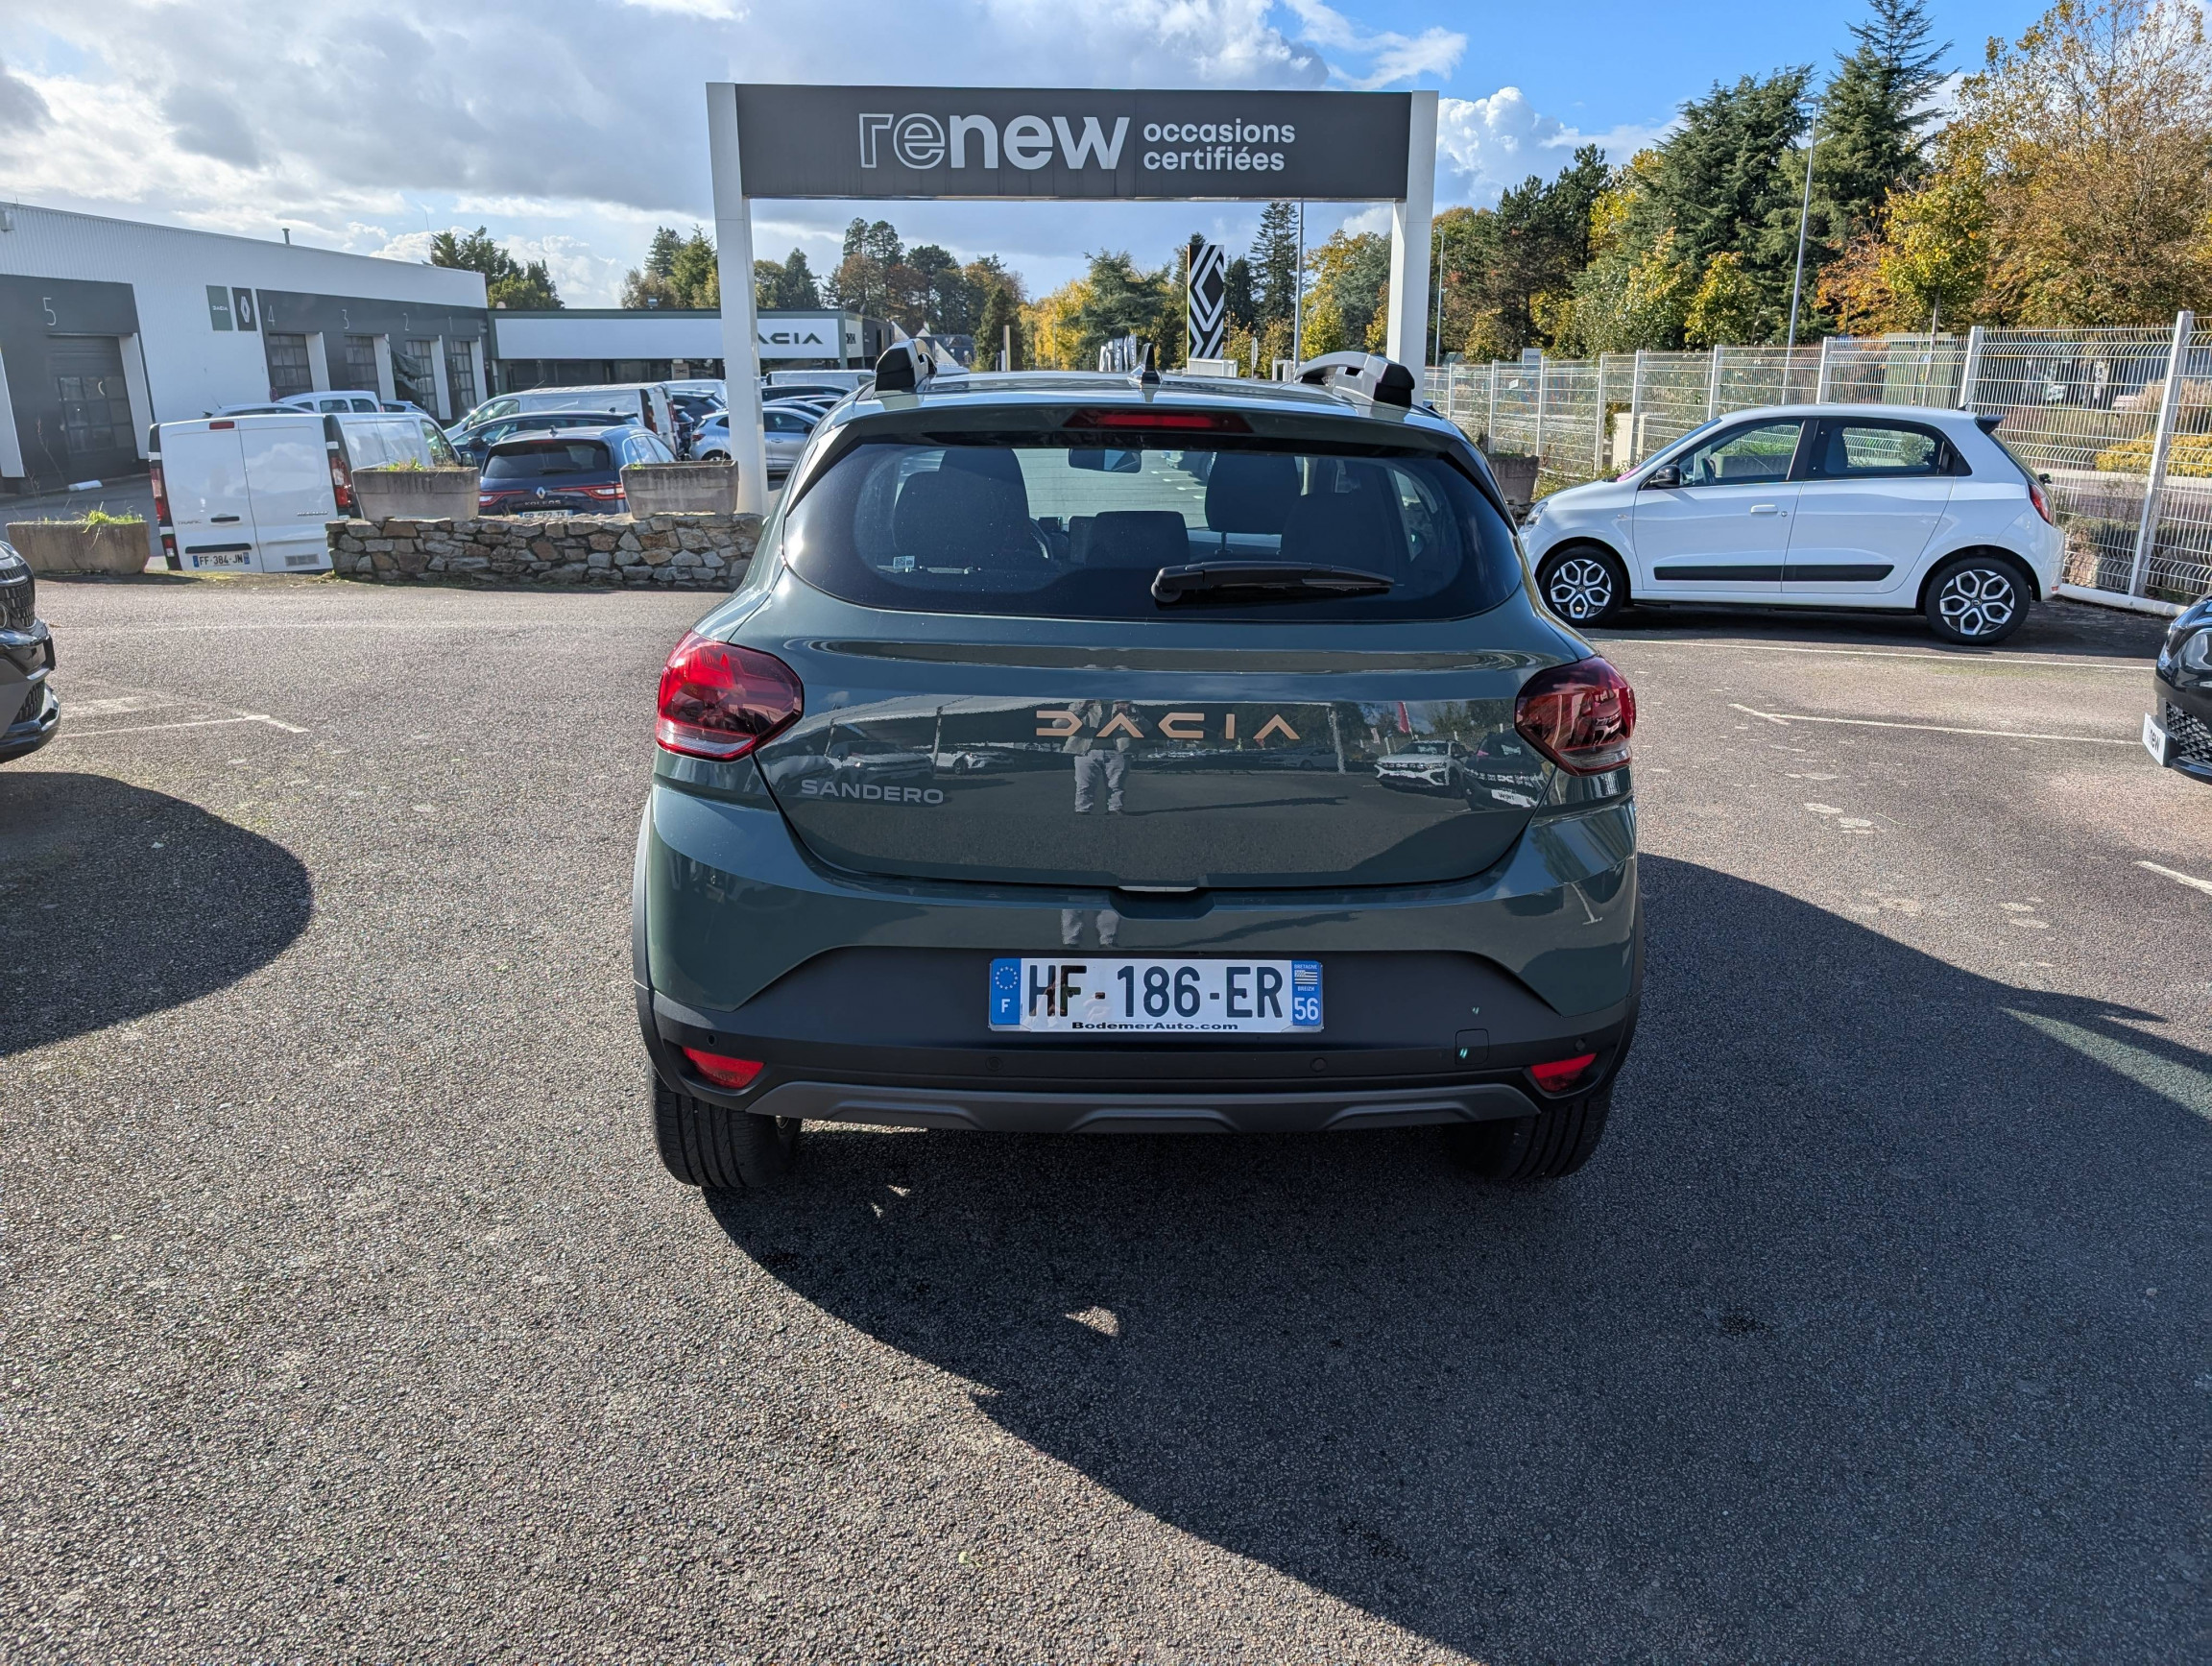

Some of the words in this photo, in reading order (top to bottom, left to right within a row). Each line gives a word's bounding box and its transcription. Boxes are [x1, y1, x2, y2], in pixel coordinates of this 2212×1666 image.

[859, 112, 1131, 170] renew
[1142, 117, 1296, 143] occasions
[1142, 146, 1285, 171] certifiées
[42, 297, 57, 326] 5
[267, 304, 276, 326] 4
[341, 308, 349, 329] 3
[402, 312, 410, 331] 2
[757, 332, 824, 345] CIA
[199, 554, 243, 566] FF-384-JN
[1036, 711, 1301, 739] DACIA
[801, 779, 944, 805] SANDERO
[1028, 964, 1284, 1019] HF-186-ER
[1001, 998, 1011, 1013] F
[1294, 997, 1319, 1021] 56
[1071, 1021, 1239, 1030] BodemerAuto.com
